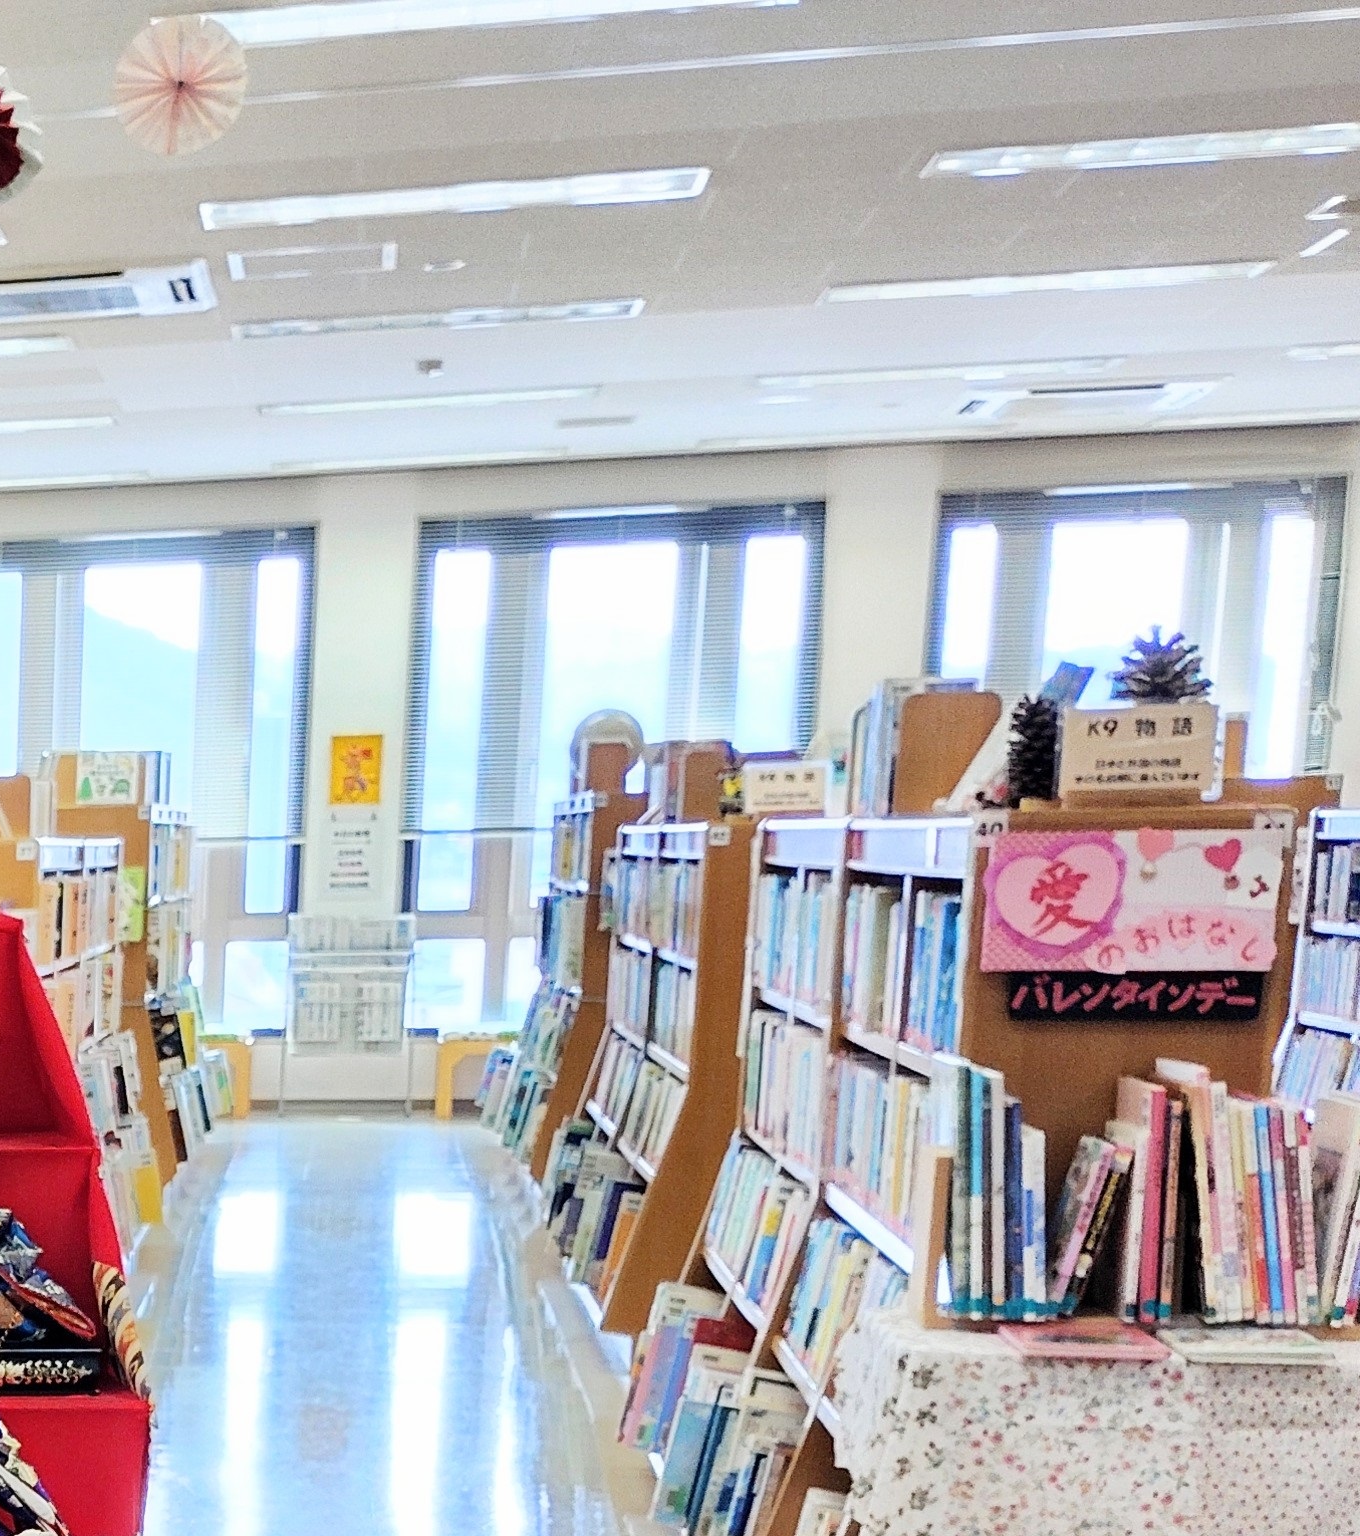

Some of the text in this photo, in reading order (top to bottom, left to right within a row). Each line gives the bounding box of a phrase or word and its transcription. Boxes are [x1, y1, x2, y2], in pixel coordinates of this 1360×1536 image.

[1086, 716, 1118, 737] K9
[1030, 861, 1102, 937] 愛
[1097, 913, 1259, 970] のおはなし
[1011, 973, 1256, 1013] バレンタインデー
